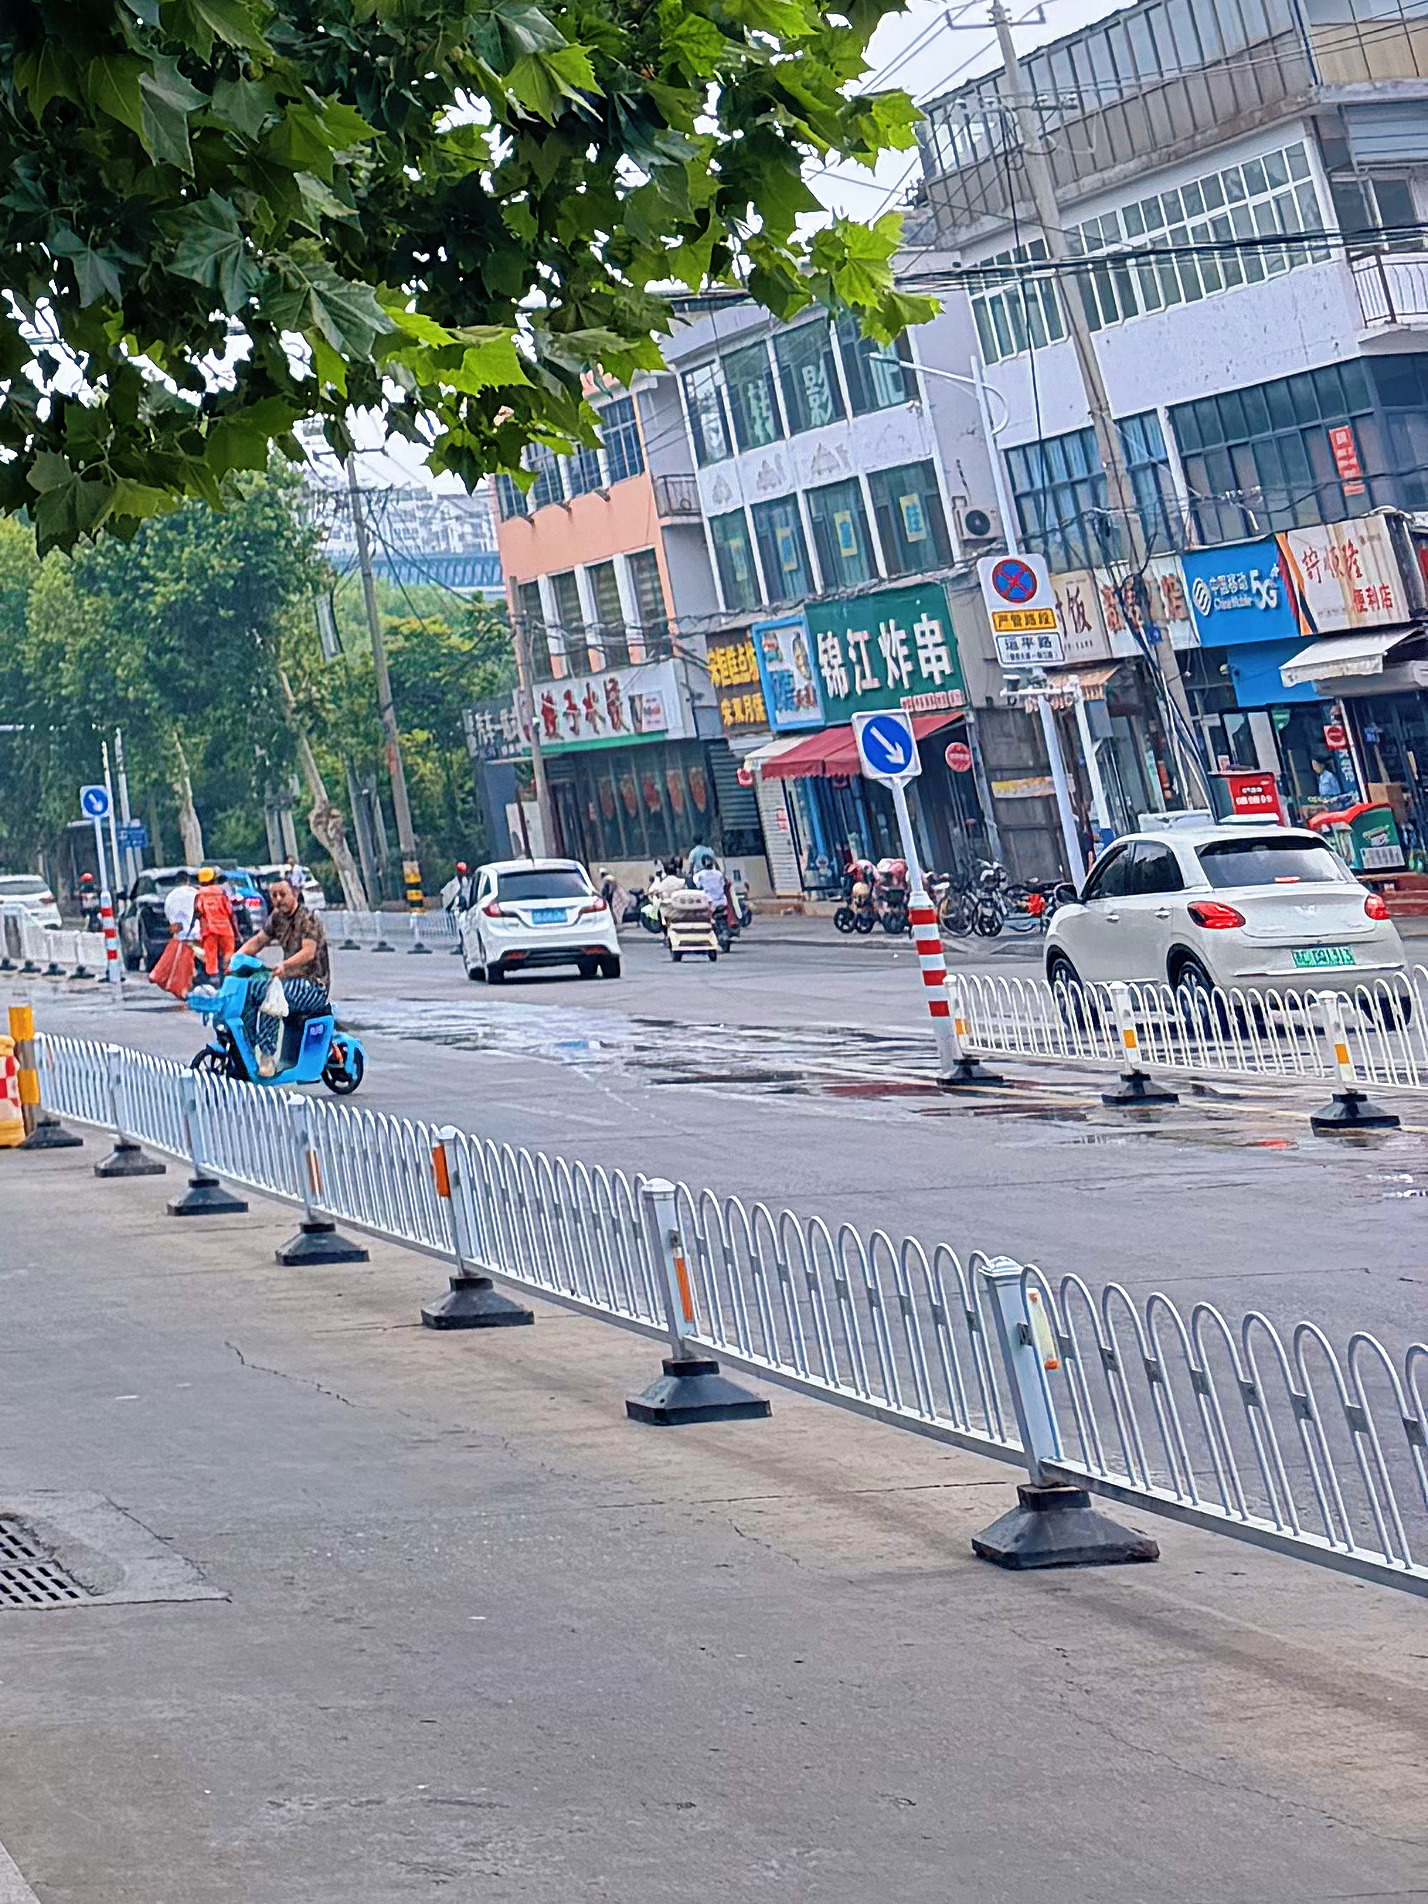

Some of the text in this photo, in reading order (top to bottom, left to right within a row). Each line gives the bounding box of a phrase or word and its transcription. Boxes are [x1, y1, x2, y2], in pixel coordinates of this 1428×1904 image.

[1209, 571, 1249, 595] 中国移动
[1353, 583, 1394, 614] 便利店
[817, 612, 954, 700] 锦江炸串
